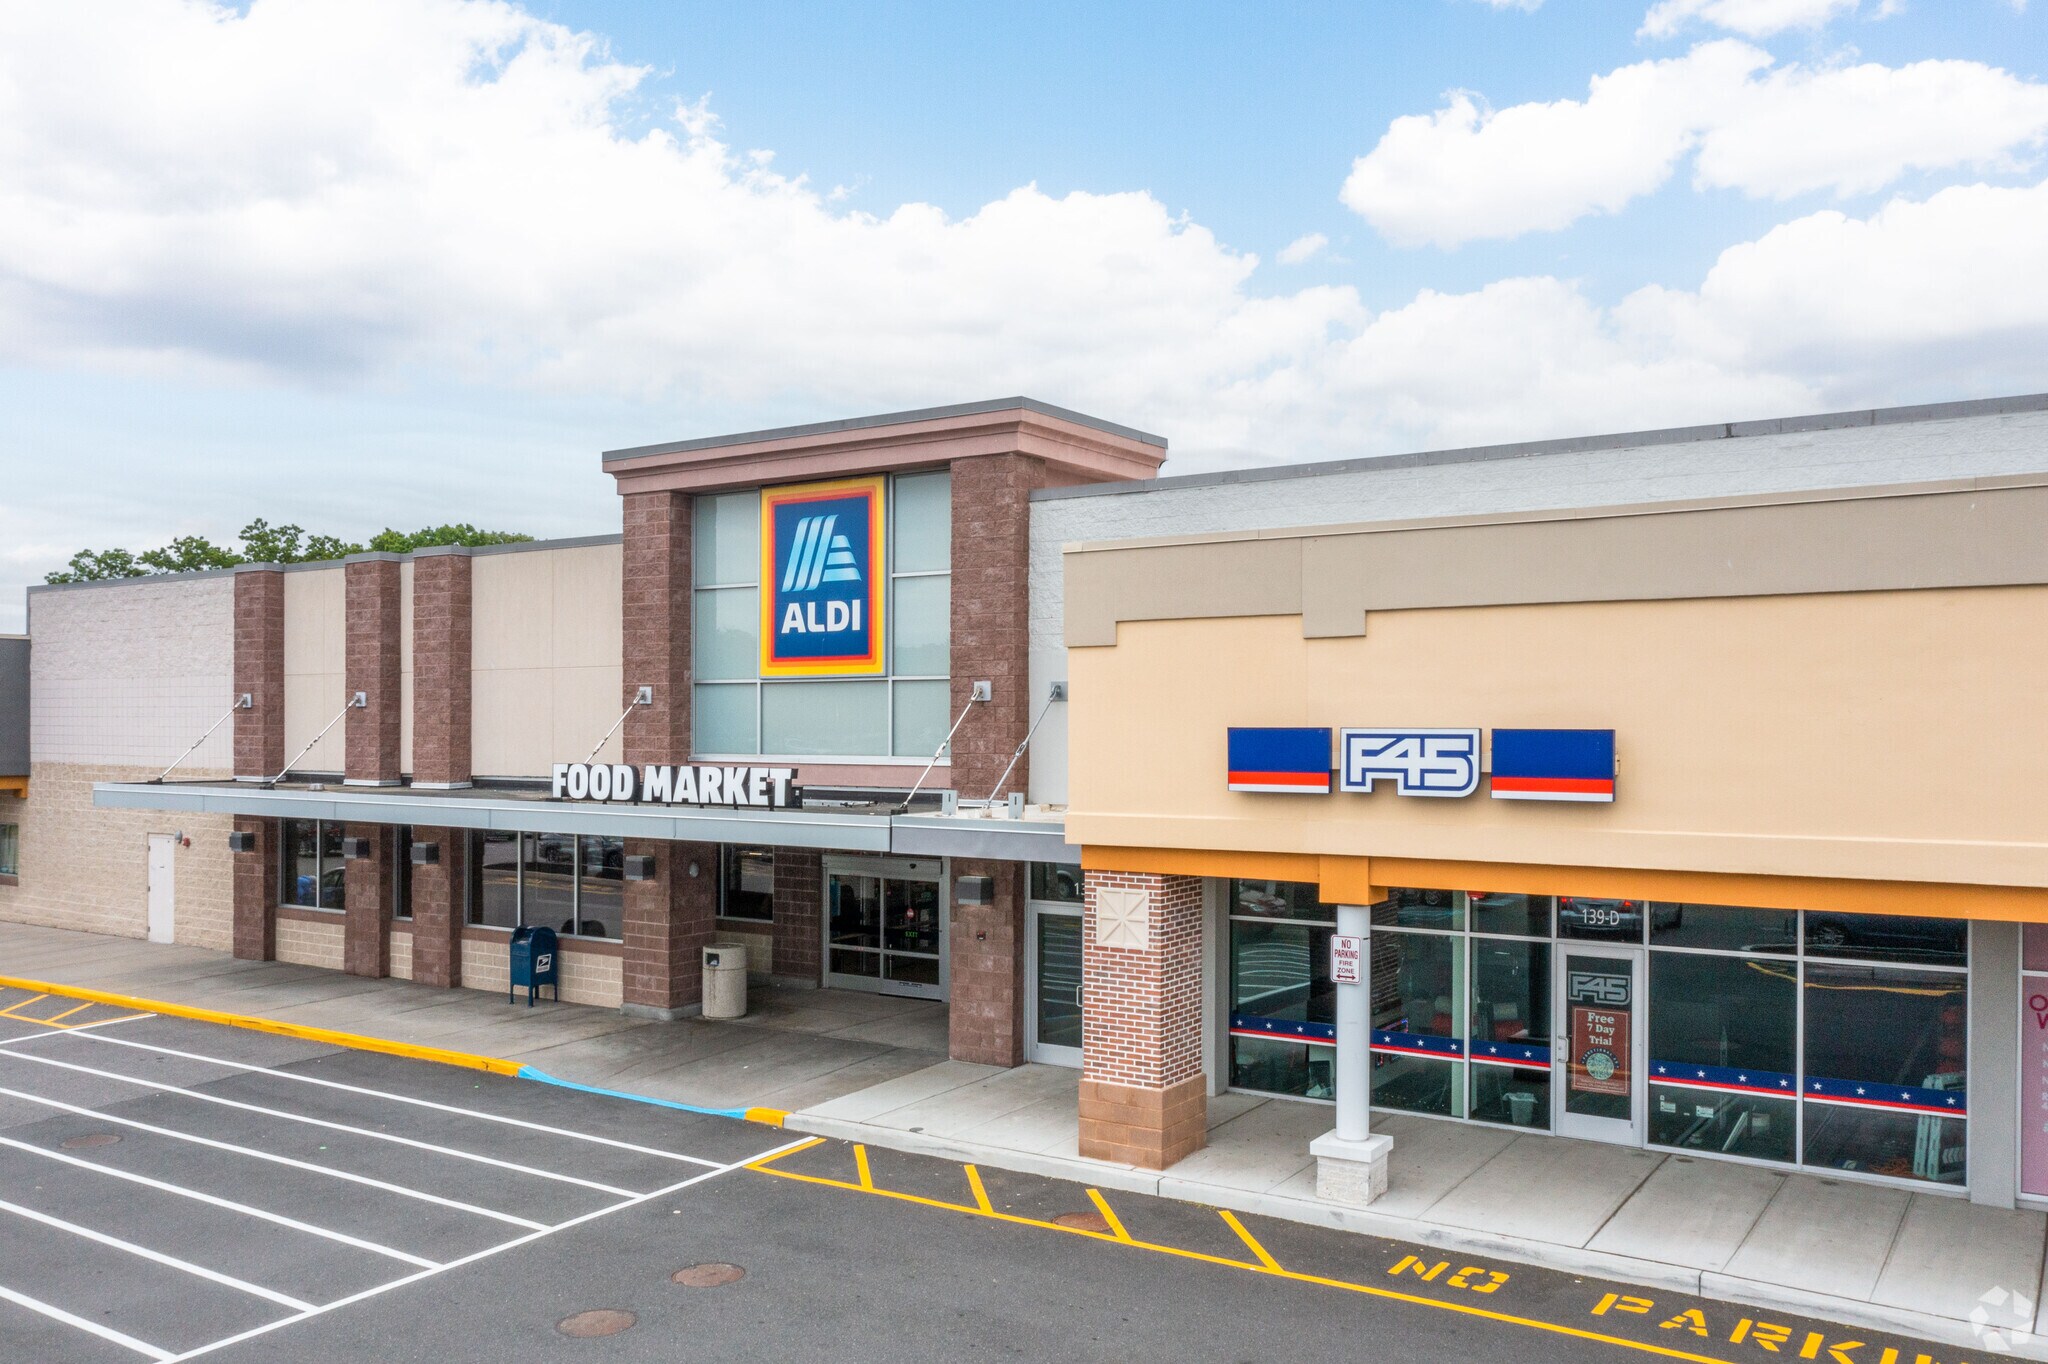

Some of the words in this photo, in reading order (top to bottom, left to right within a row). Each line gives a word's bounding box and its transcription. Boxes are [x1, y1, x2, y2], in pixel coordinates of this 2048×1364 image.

[781, 599, 861, 634] ALDI
[1346, 734, 1476, 791] F45
[552, 763, 635, 801] FOOD
[642, 765, 792, 807] MARKET
[1582, 908, 1620, 925] 139-D
[1341, 939, 1352, 949] NO
[1334, 949, 1359, 960] PARKING
[1570, 973, 1629, 1003] F45
[1587, 1011, 1615, 1024] Free
[1587, 1023, 1593, 1032] 7
[1595, 1024, 1615, 1036] Day
[1589, 1035, 1612, 1046] Trial
[1387, 1255, 1510, 1293] NO
